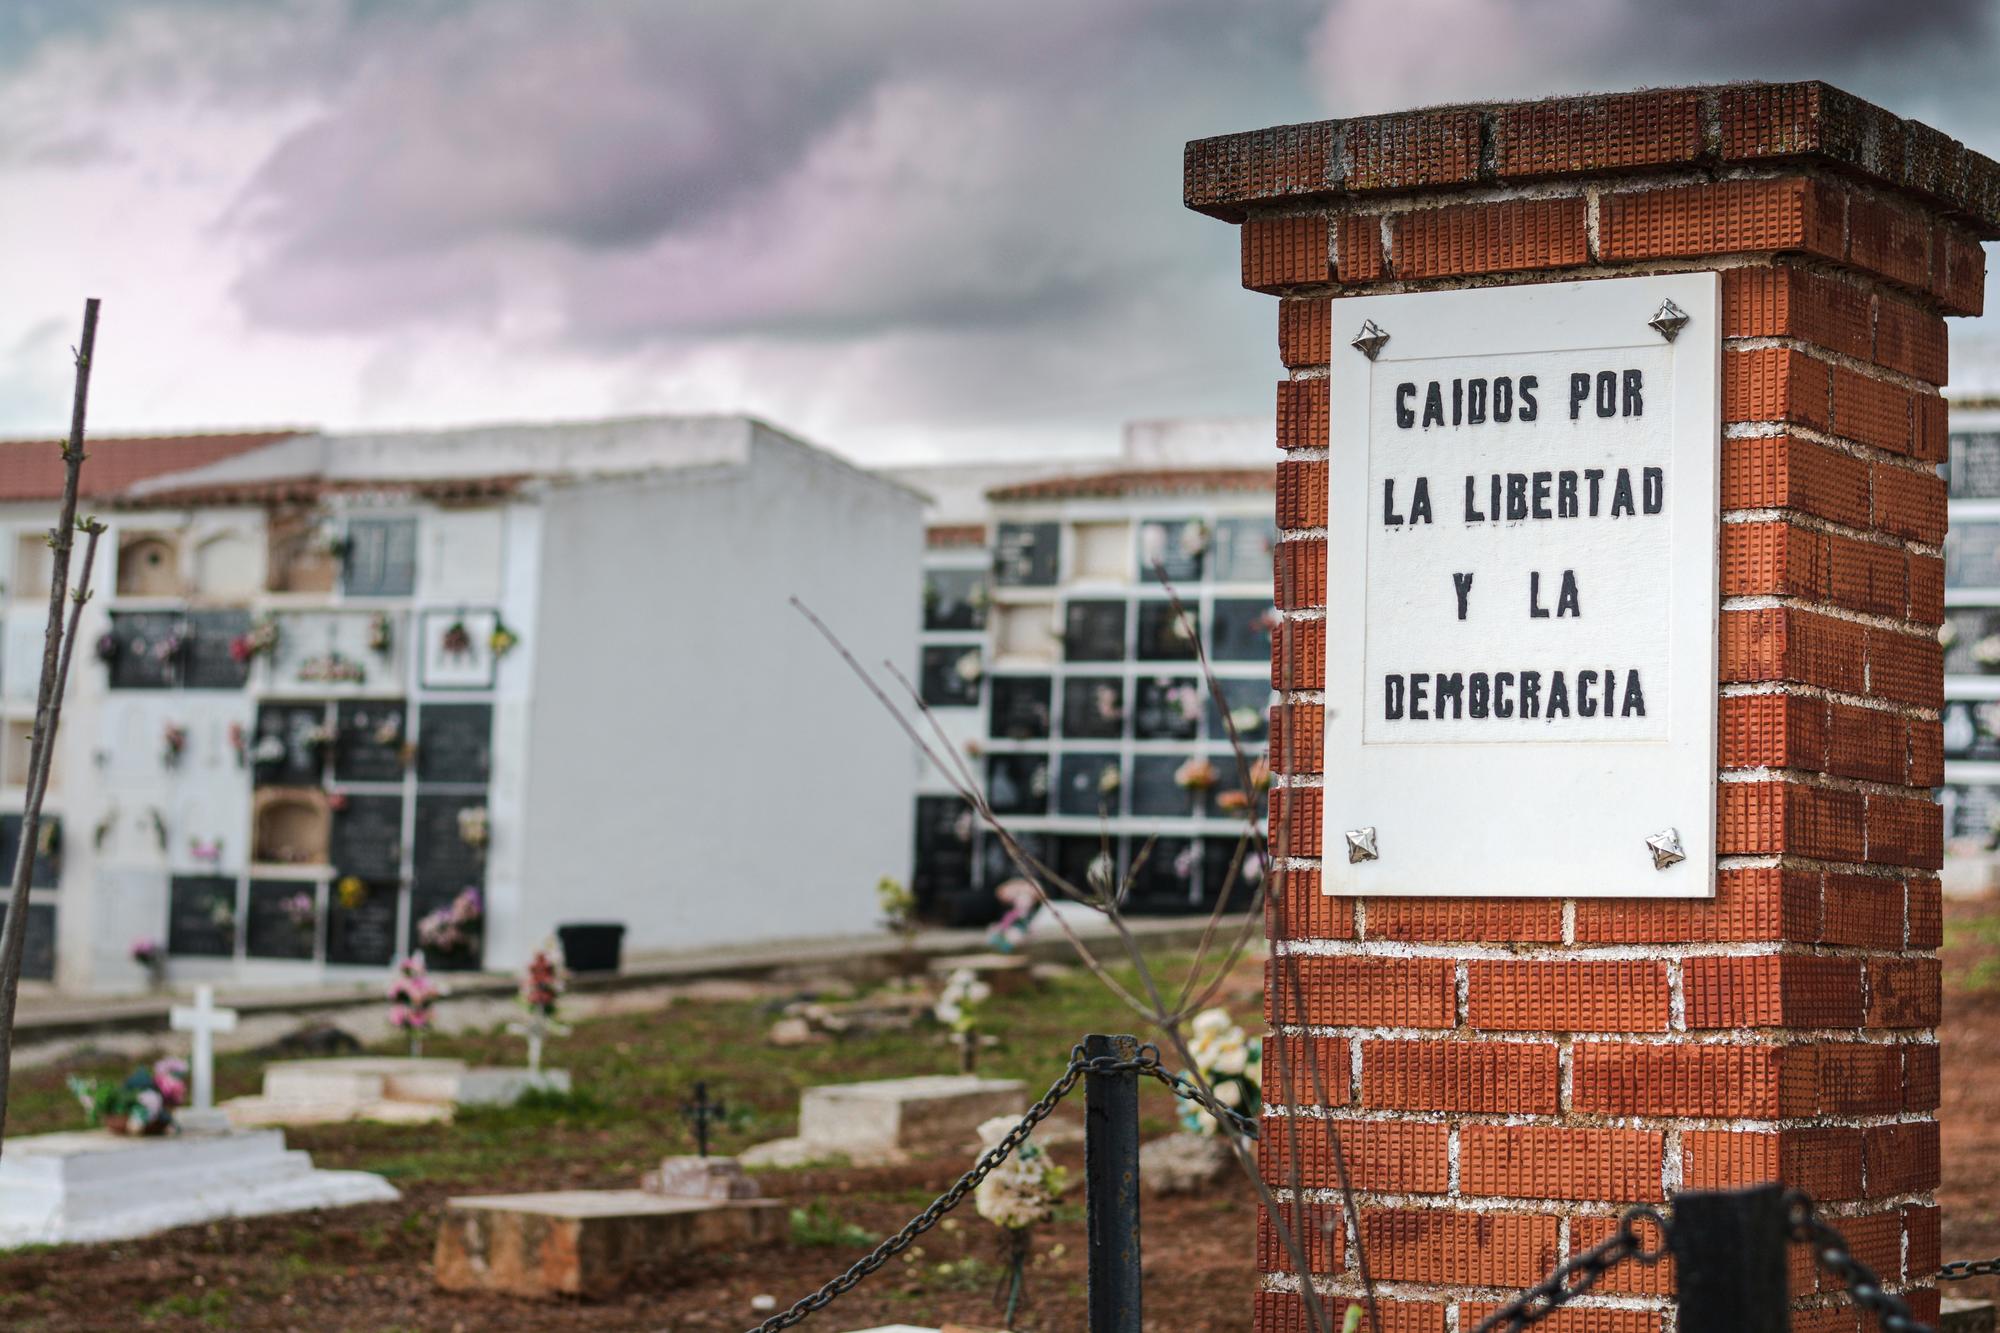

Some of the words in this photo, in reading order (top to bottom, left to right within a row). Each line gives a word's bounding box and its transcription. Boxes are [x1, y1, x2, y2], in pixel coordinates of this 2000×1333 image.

[1396, 375, 1538, 429] CAIDOS
[1570, 369, 1643, 419] POR
[1384, 477, 1433, 526] LA
[1465, 467, 1663, 522] LIBERTAD
[1453, 572, 1474, 620] Y
[1530, 570, 1581, 618] LA
[1385, 669, 1646, 720] DEMOCRACIA
